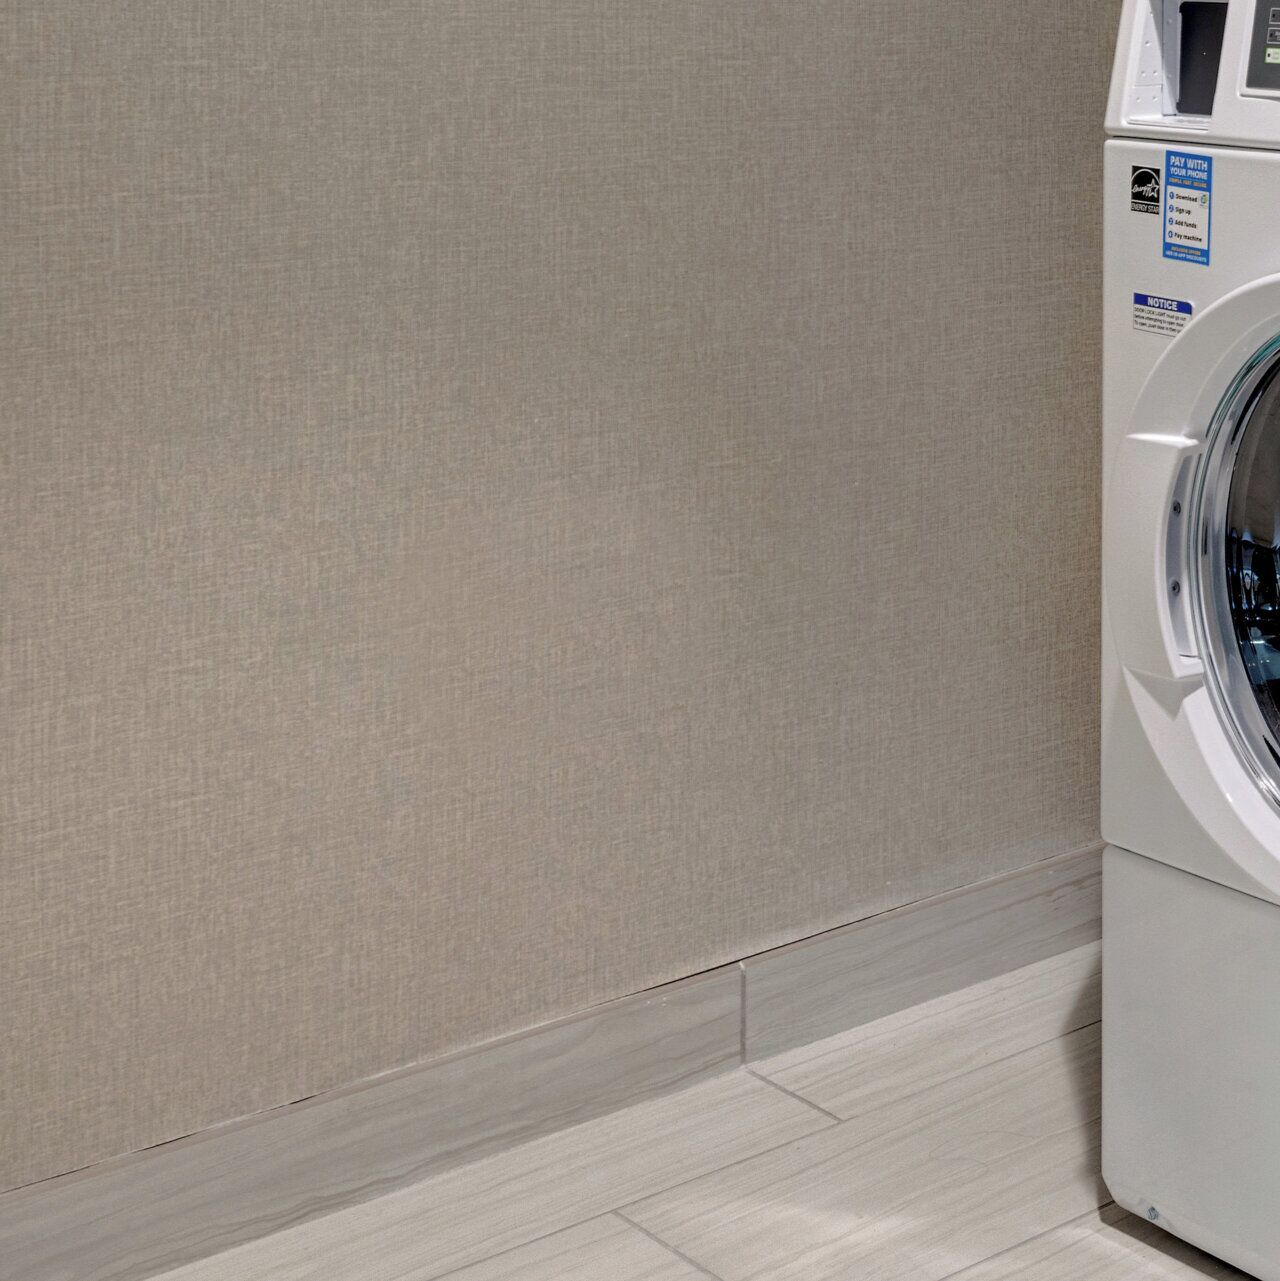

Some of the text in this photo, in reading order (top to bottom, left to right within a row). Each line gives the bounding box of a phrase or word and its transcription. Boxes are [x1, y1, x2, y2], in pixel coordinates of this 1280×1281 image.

[1169, 155, 1208, 171] PAY WITH
[1170, 166, 1208, 180] YOUR PHONE
[1175, 193, 1198, 203] Download
[1131, 201, 1160, 214] ENERGY STAR
[1175, 206, 1192, 216] Sign up
[1174, 218, 1197, 229] Add funds
[1174, 231, 1202, 243] Pay machine
[1147, 296, 1178, 311] NOTICE
